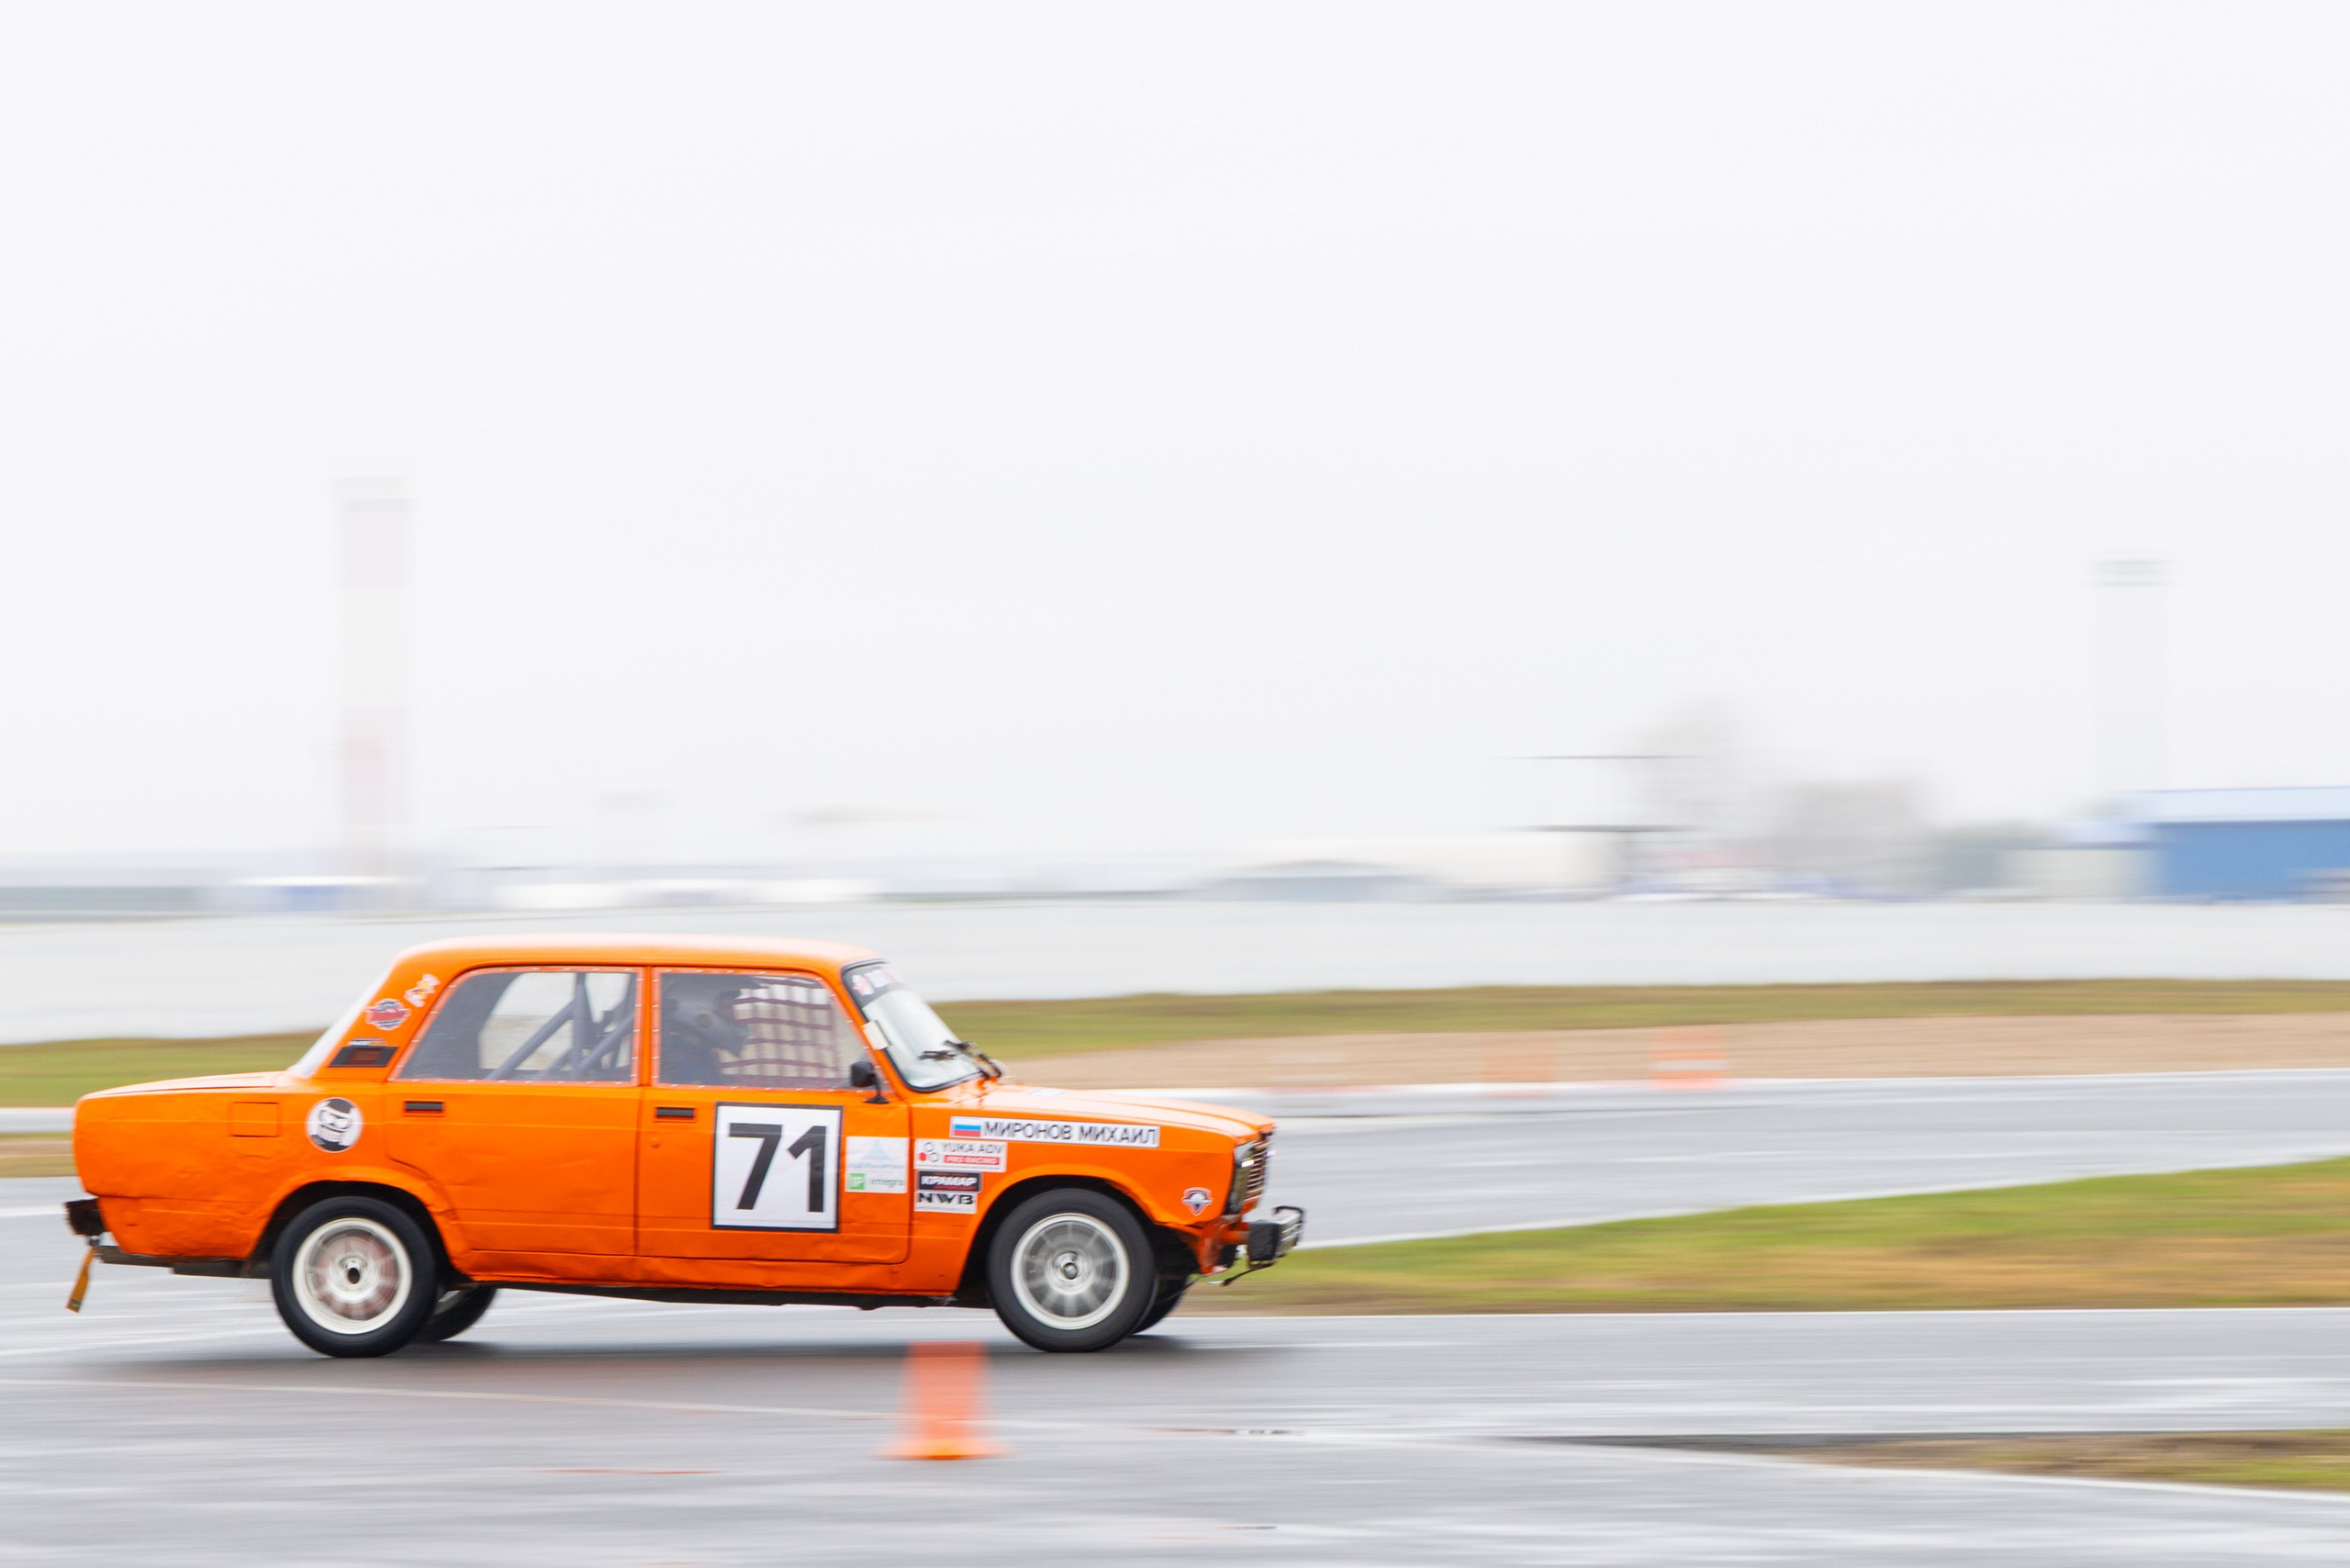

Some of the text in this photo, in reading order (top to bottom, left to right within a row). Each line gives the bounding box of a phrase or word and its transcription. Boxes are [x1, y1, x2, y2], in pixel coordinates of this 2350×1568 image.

[983, 1121, 1158, 1144] МИРОНОВ МИХАИЛ
[727, 1122, 827, 1213] 71
